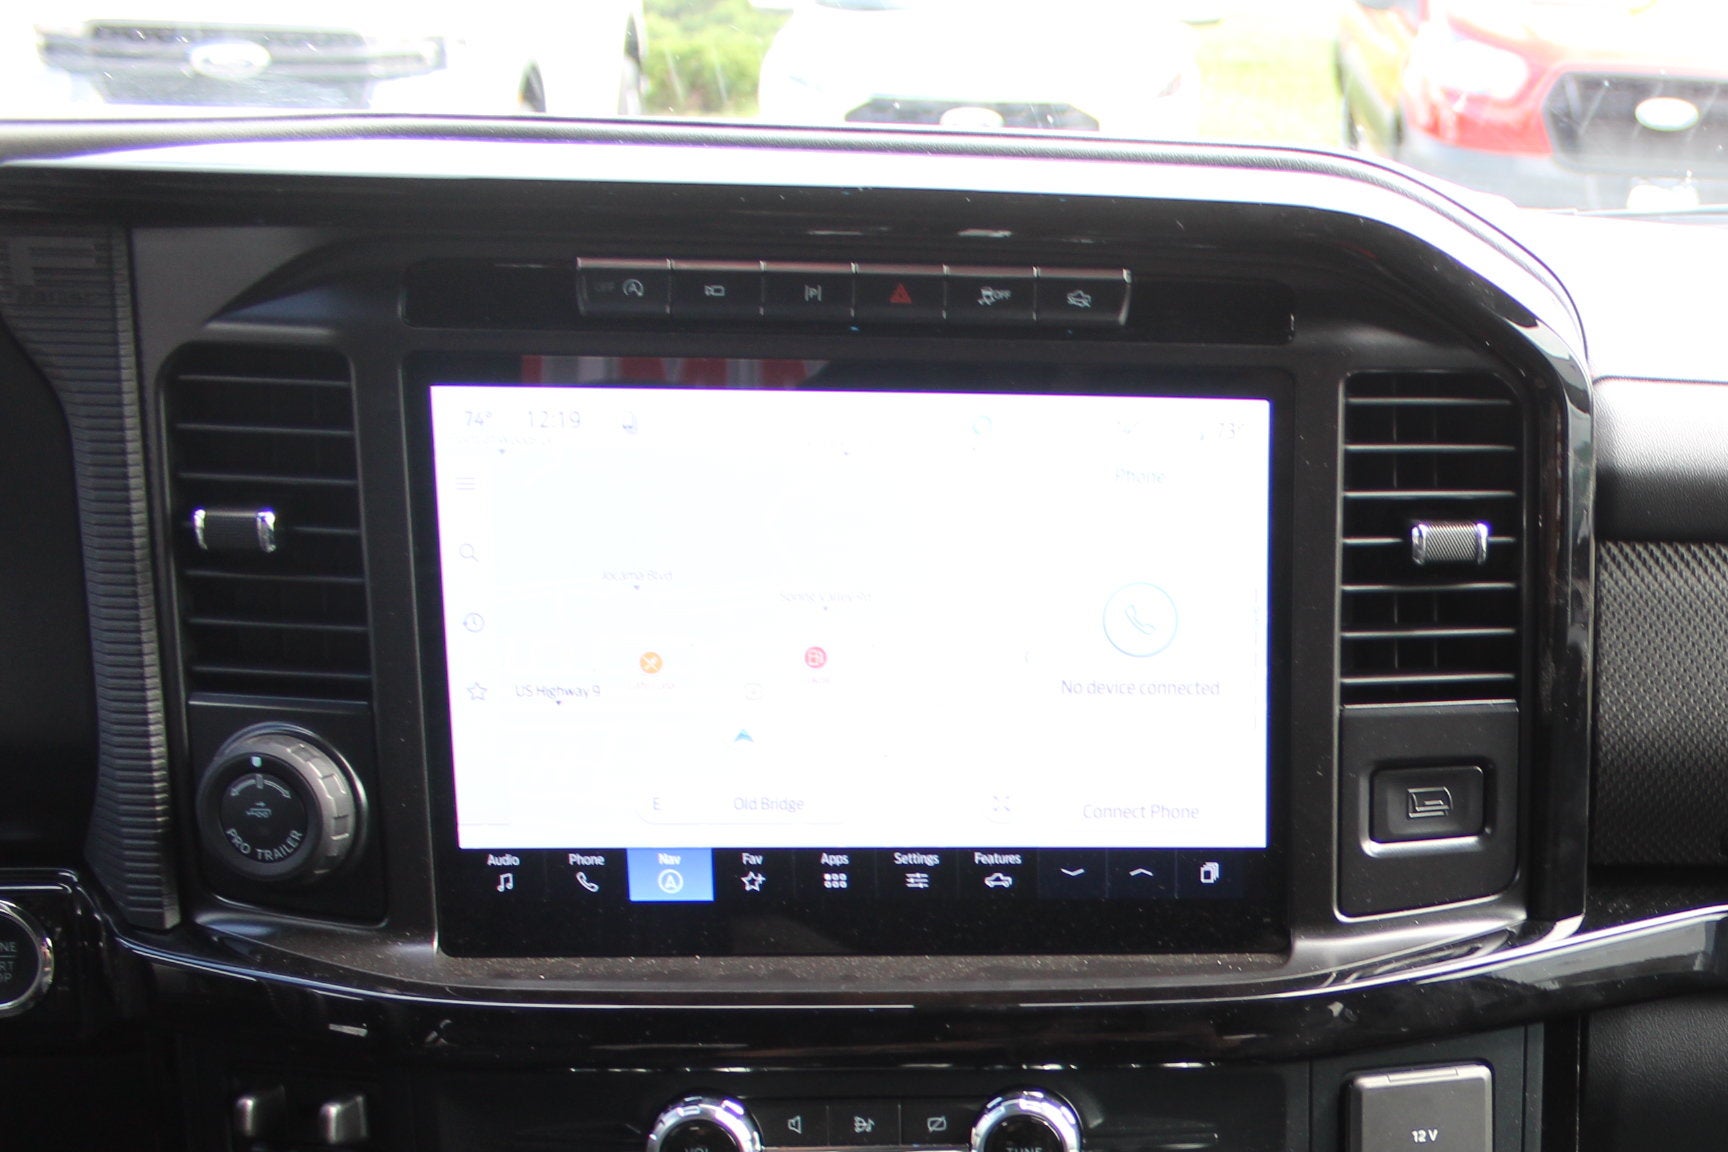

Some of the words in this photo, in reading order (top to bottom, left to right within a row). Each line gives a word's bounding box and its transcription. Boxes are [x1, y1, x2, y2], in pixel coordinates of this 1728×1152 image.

[515, 684, 534, 698] US
[536, 684, 589, 701] Highway
[591, 683, 601, 696] 9
[1060, 679, 1083, 696] No
[1086, 679, 1136, 696] device
[1139, 679, 1220, 697] connected
[733, 796, 758, 812] Old
[760, 795, 805, 815] Bridge
[1082, 803, 1146, 820] Connect
[1149, 803, 1200, 820] Phone
[226, 828, 252, 855] PRO
[256, 830, 303, 861] TRAILER
[487, 853, 520, 866] Audio
[568, 853, 605, 866] Phone
[658, 853, 681, 865] Nav
[742, 853, 763, 865] Fav
[821, 853, 849, 867] Apps
[894, 852, 940, 866] Settings
[974, 852, 1022, 865] Features
[1412, 1130, 1426, 1143] 12
[1428, 1130, 1439, 1142] V
